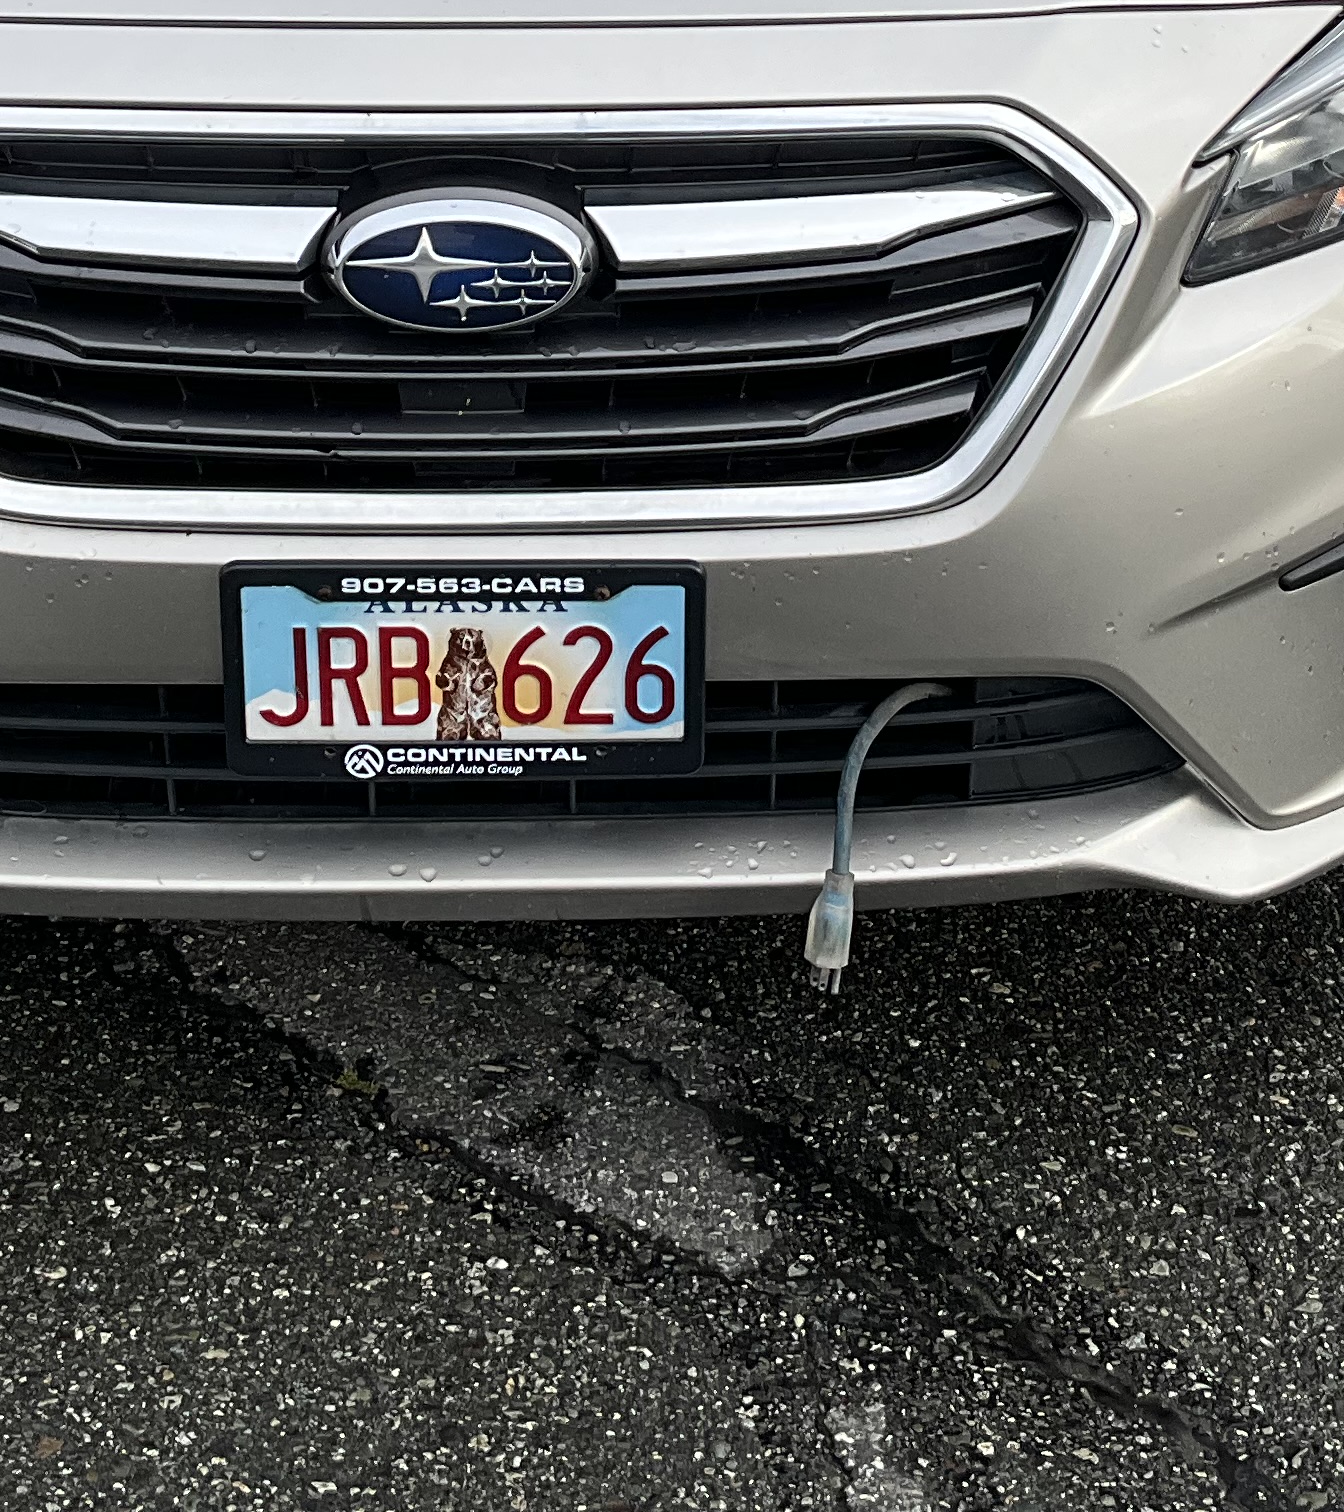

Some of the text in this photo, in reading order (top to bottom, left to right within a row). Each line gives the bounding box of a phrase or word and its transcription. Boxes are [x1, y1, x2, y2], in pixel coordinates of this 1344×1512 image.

[341, 577, 585, 594] 907-563-CARS
[259, 625, 676, 726] JRB 626
[386, 747, 587, 763] CONTINENTAL
[387, 764, 523, 776] Continental Auto Group
